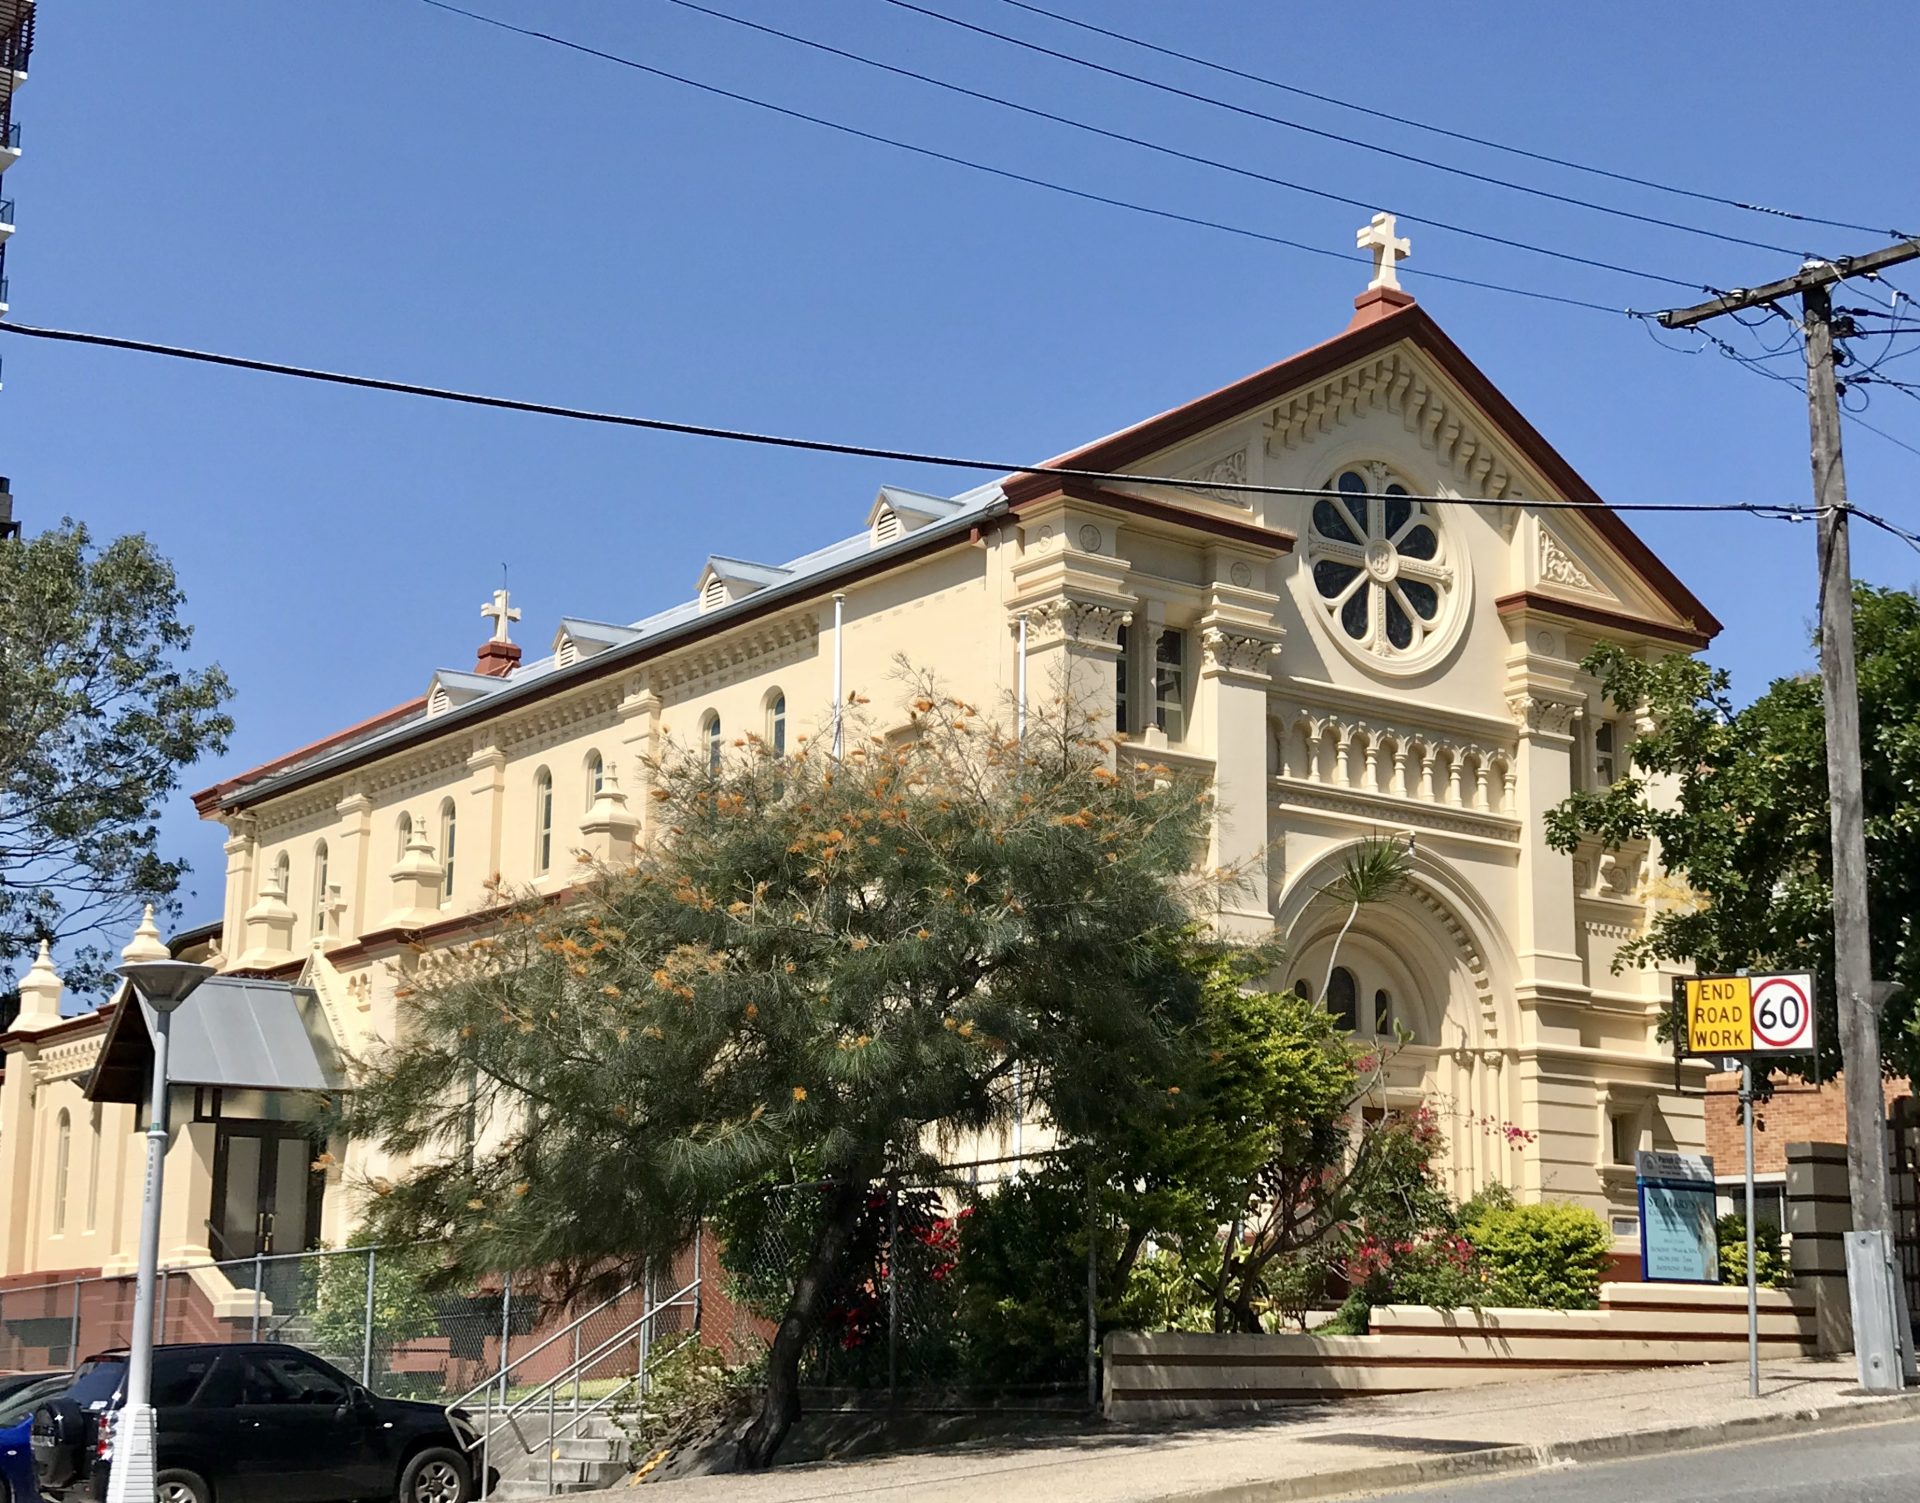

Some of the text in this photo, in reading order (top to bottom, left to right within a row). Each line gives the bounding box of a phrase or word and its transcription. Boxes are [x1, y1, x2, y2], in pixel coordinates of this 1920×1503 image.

[1701, 983, 1735, 1001] END
[1695, 1006, 1743, 1024] ROAD
[1759, 996, 1800, 1030] 60
[1695, 1030, 1745, 1047] WORK
